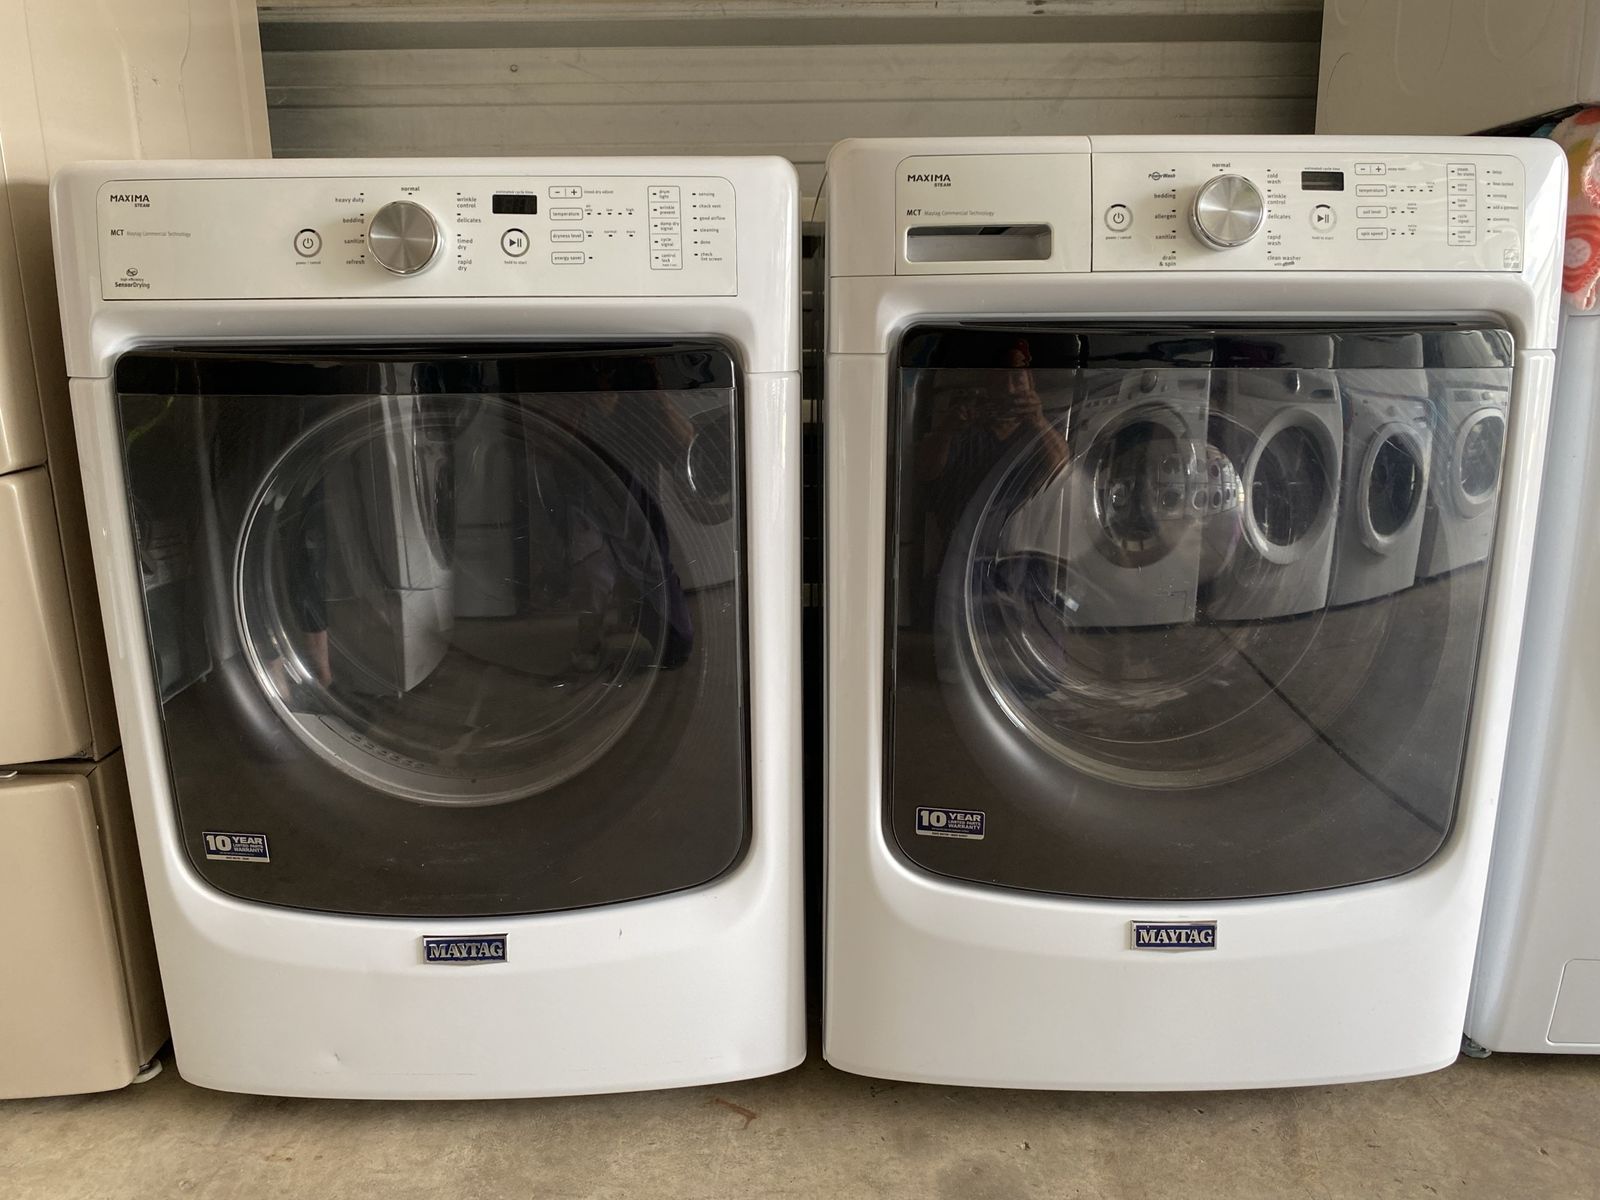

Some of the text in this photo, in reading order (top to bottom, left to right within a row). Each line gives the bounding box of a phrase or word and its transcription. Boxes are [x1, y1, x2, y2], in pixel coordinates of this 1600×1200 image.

[907, 174, 951, 182] MAXIMA
[110, 194, 150, 203] MAXIMA
[920, 810, 981, 827] 10 YEAR
[206, 835, 263, 851] 10 YEAR
[1138, 929, 1213, 944] MAYTAG
[429, 941, 503, 958] MAYTAG
